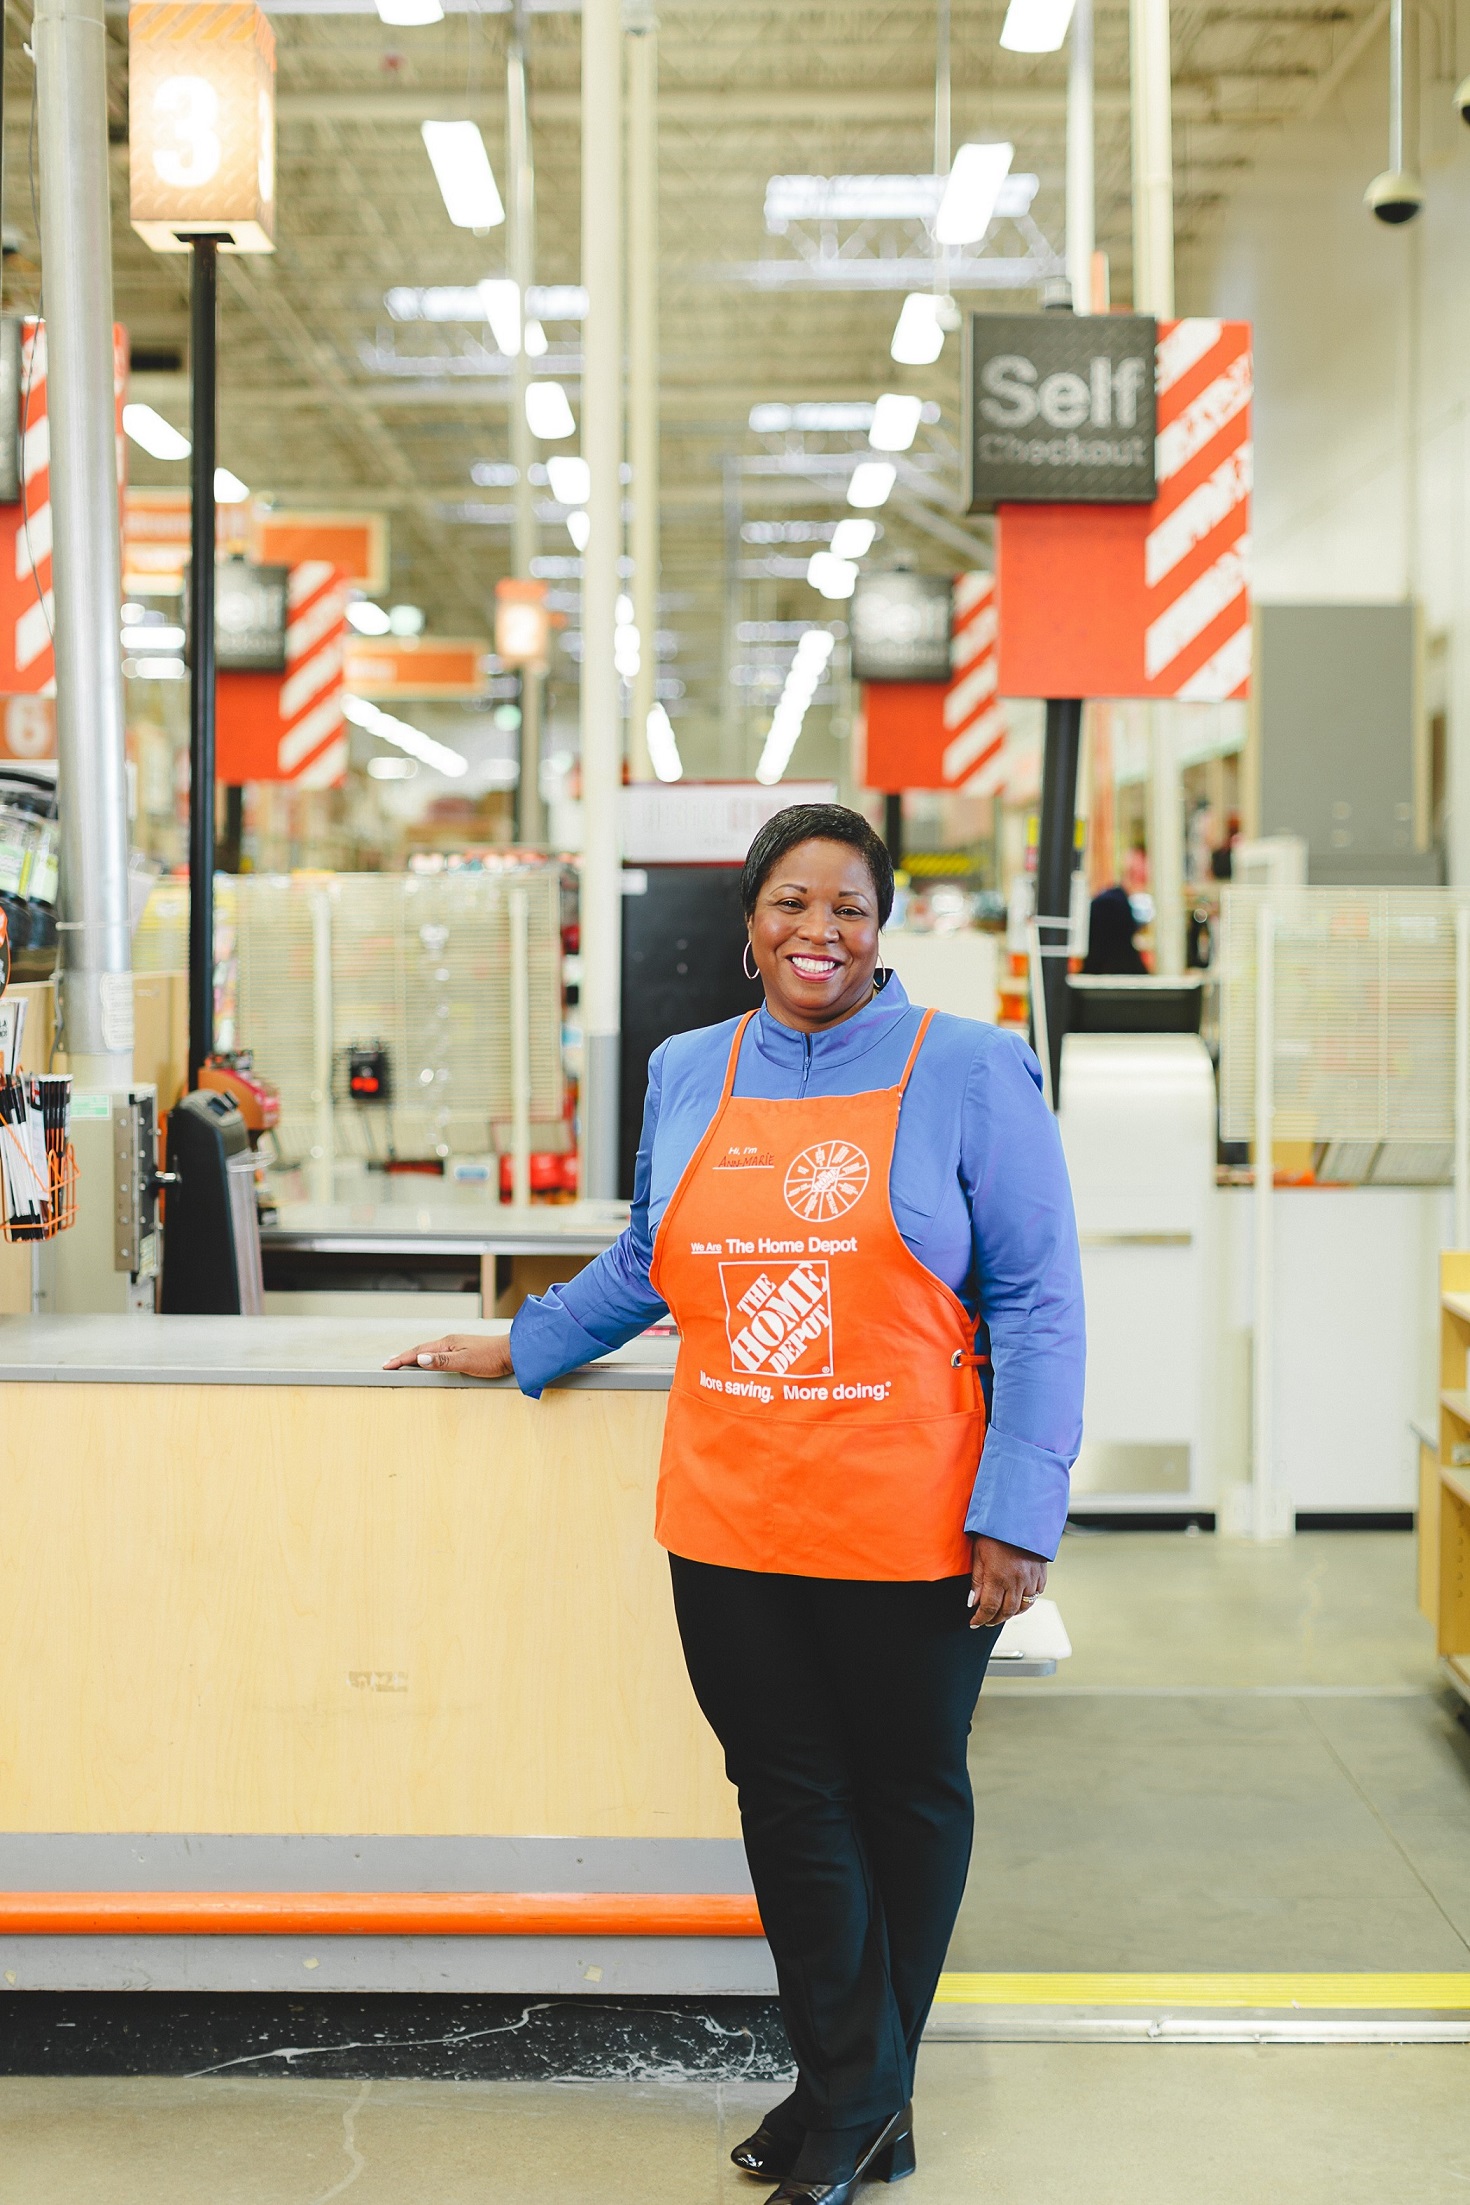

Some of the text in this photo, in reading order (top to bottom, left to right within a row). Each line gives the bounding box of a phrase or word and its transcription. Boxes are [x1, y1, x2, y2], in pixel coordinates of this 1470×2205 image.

[152, 75, 220, 188] 3
[978, 354, 1147, 428] Self
[977, 433, 1149, 467] Checkout
[4, 694, 51, 758] 6
[728, 1146, 758, 1155] Hi, I'm
[691, 1236, 858, 1255] We Are The Home Depot
[731, 1262, 829, 1372] HOME
[736, 1273, 777, 1318] THE
[768, 1303, 831, 1375] DEPOT
[699, 1370, 723, 1392] More
[725, 1381, 775, 1404] saving.
[783, 1385, 828, 1400] More
